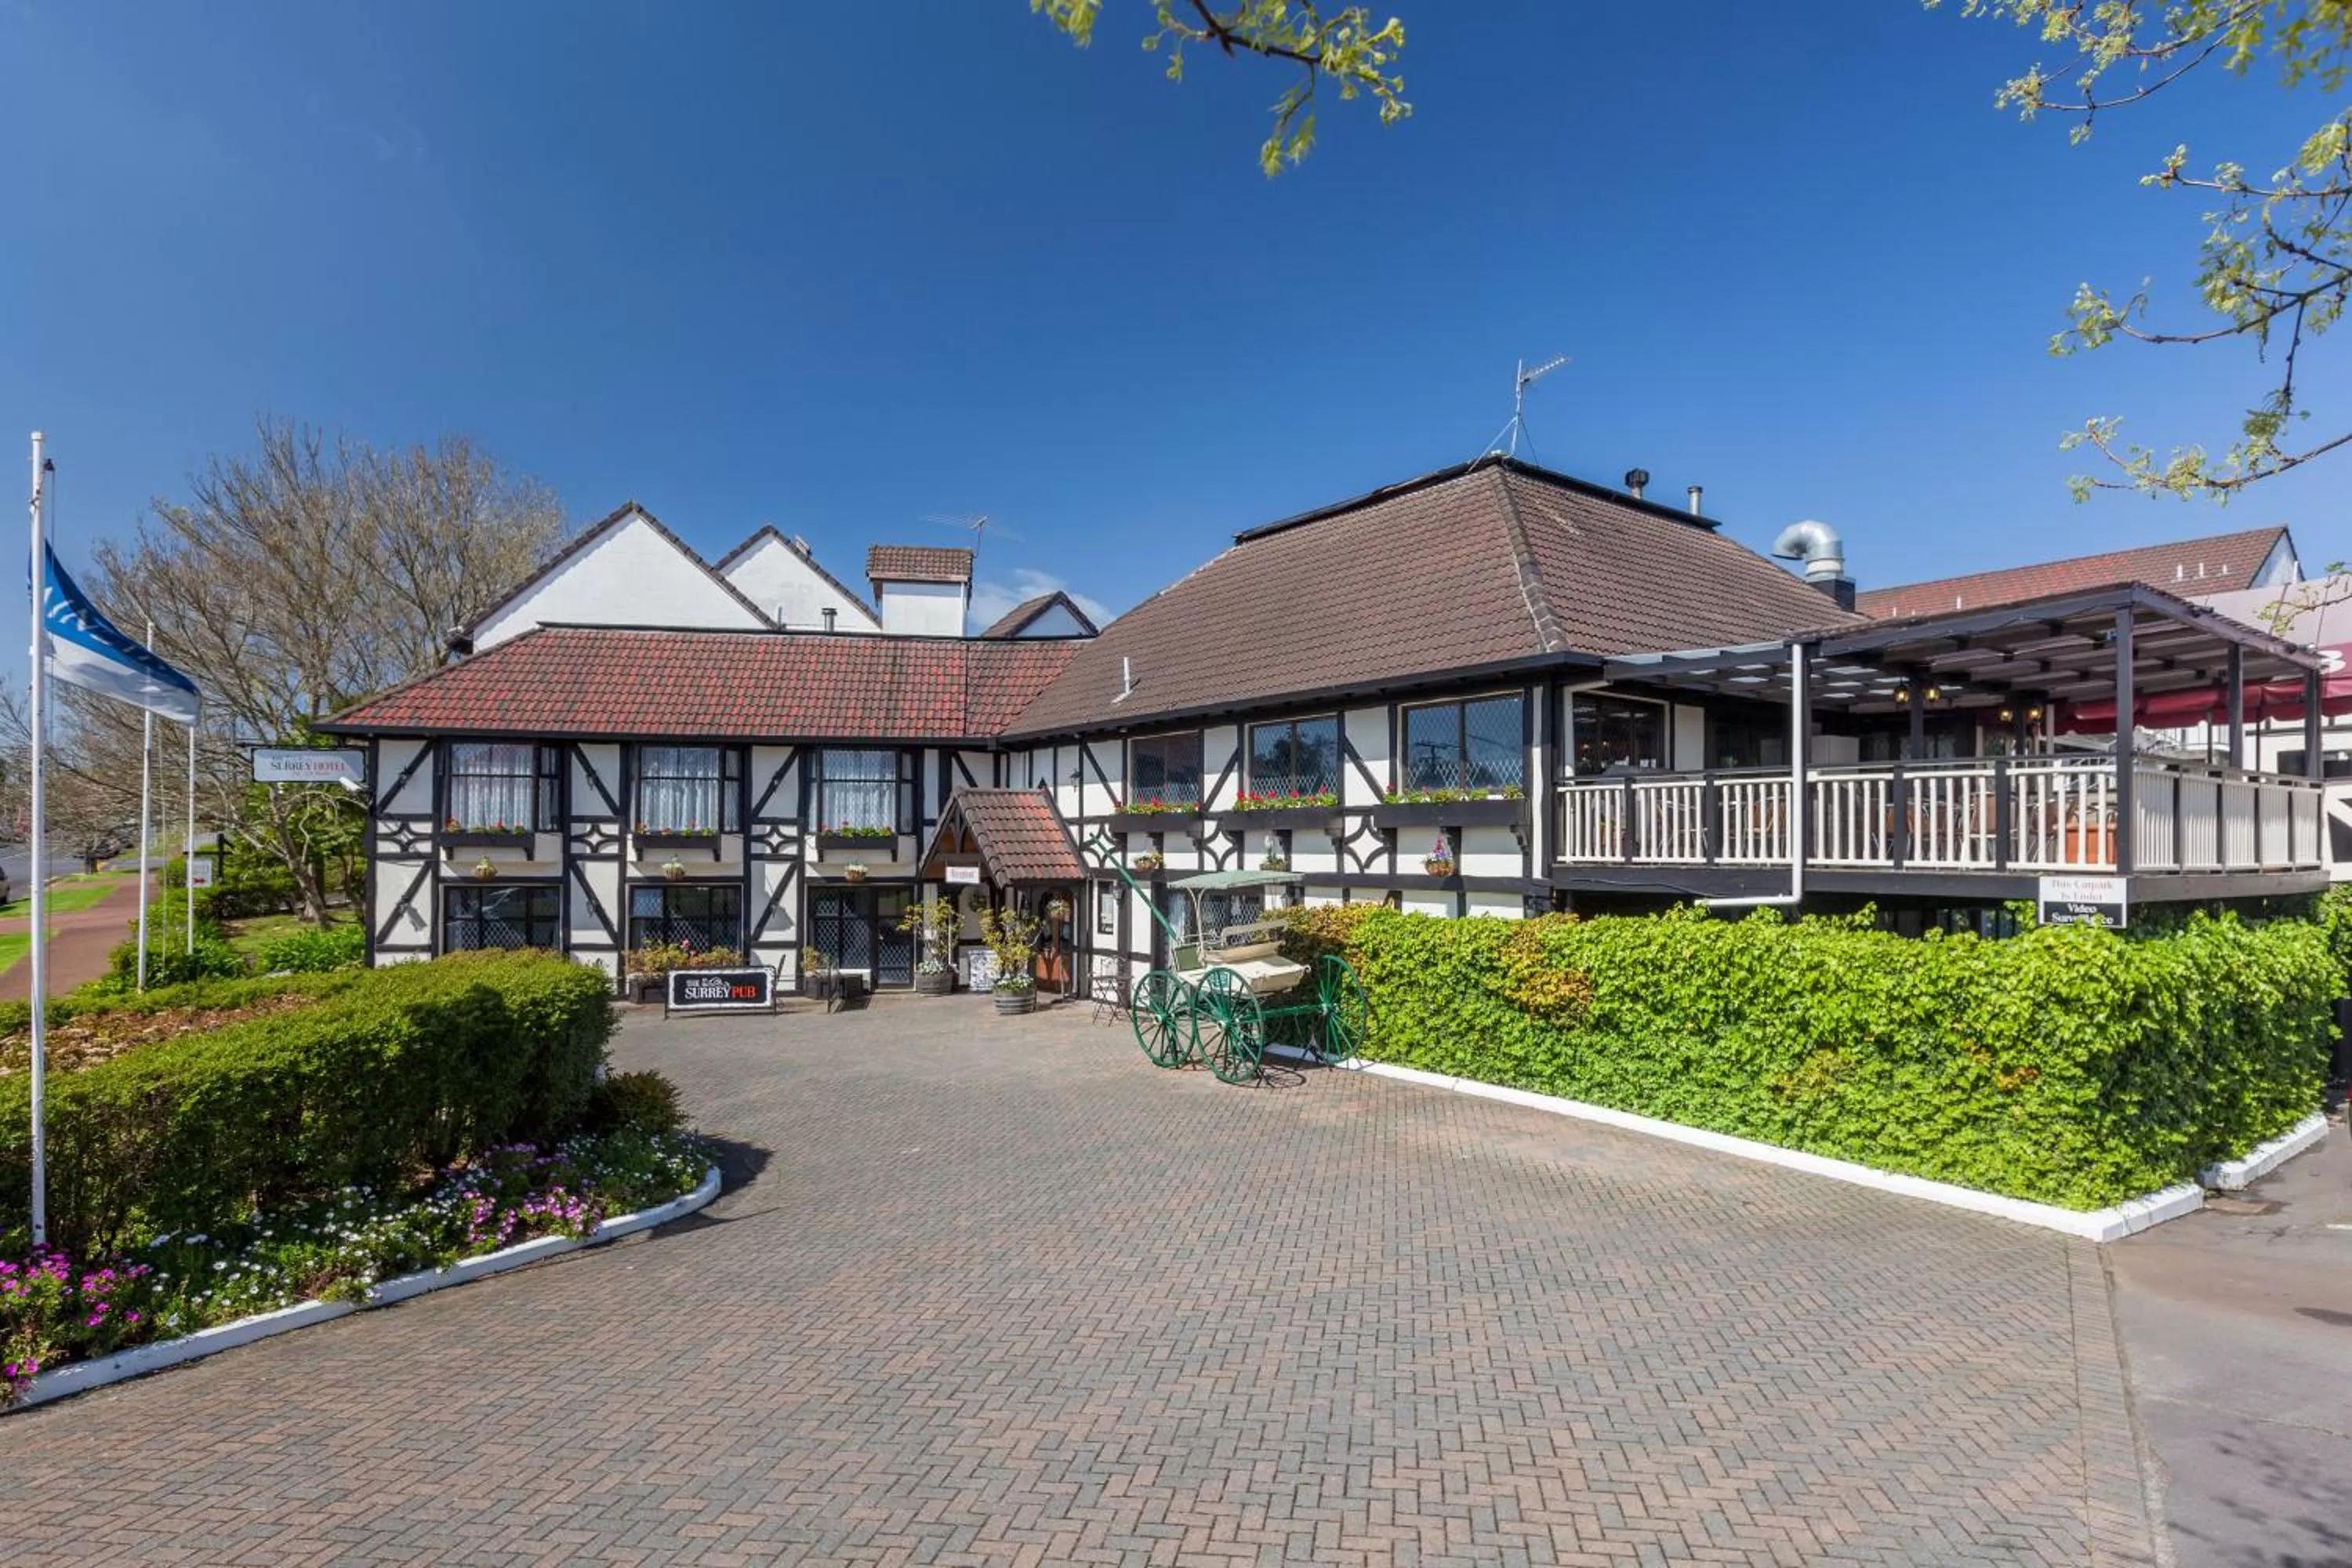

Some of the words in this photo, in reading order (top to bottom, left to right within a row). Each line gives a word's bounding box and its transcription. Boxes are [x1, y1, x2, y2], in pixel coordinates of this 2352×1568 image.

[270, 761, 310, 771] SURREY
[313, 761, 345, 771] HOTEL
[2051, 879, 2071, 888] This
[2067, 903, 2098, 913] Video
[684, 986, 731, 1000] SURREY
[731, 985, 757, 998] PUB
